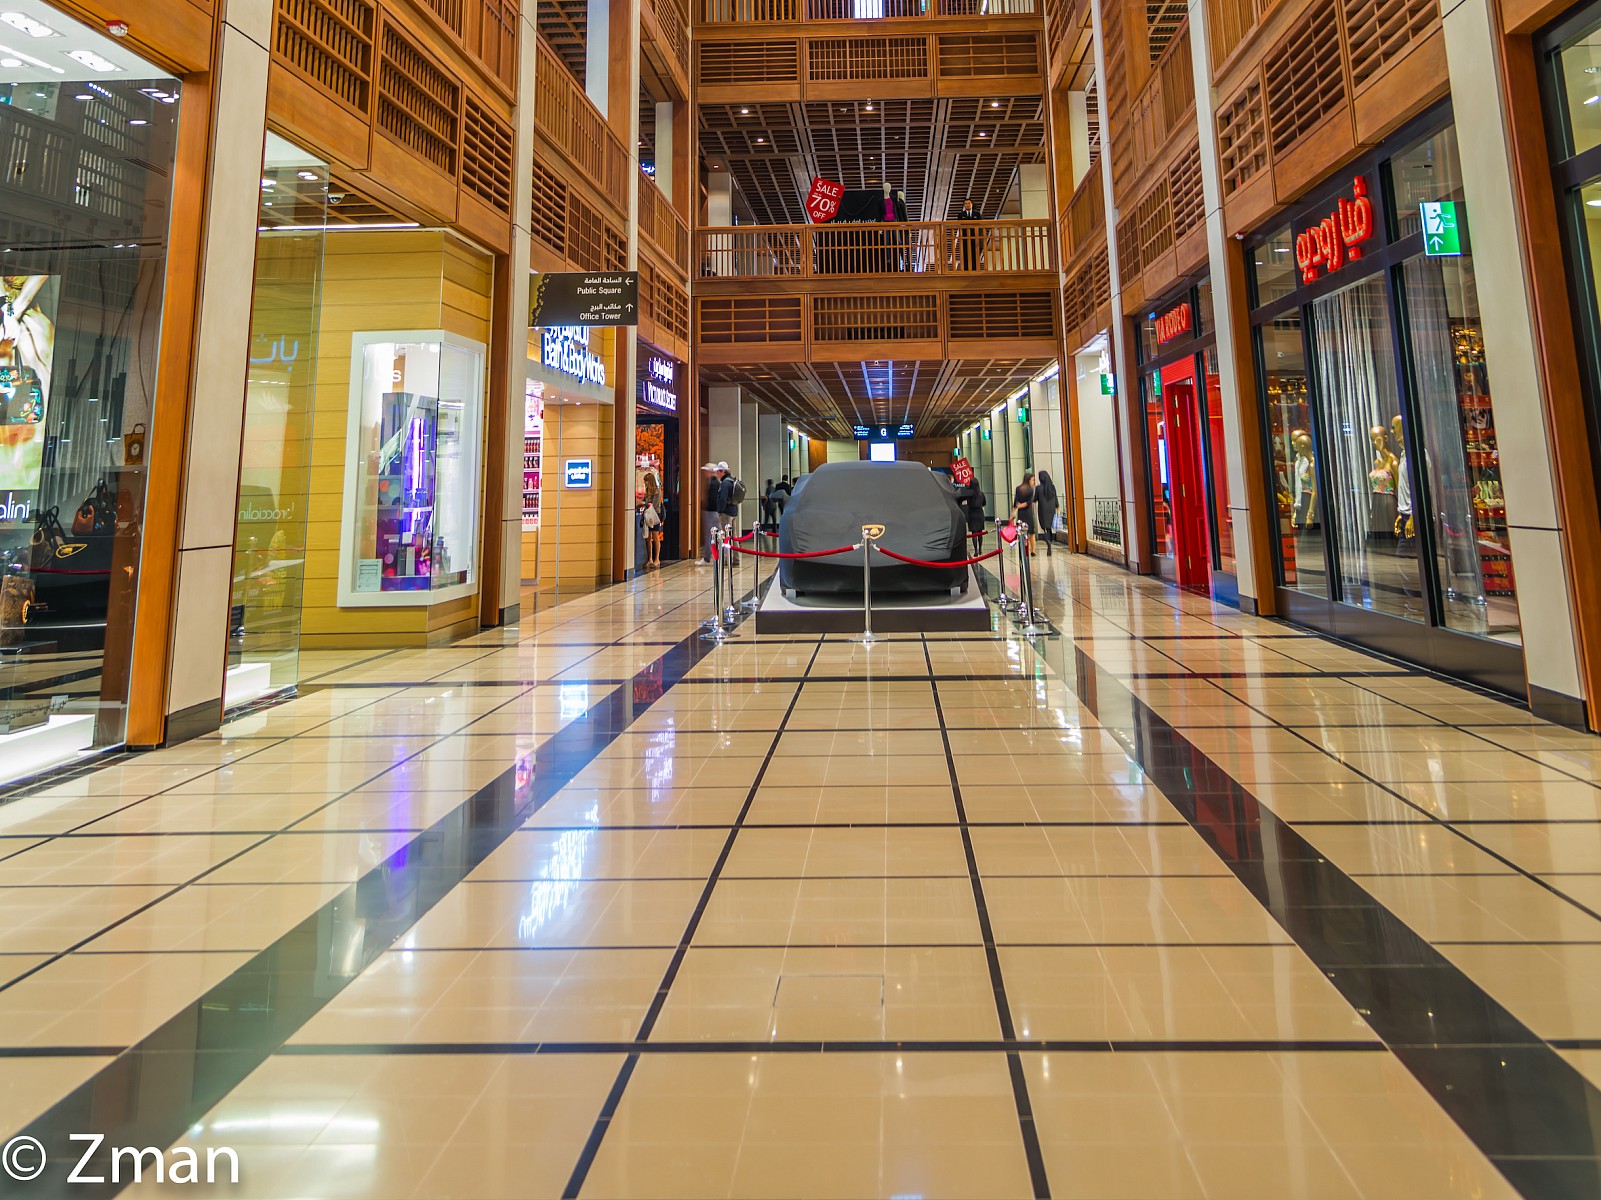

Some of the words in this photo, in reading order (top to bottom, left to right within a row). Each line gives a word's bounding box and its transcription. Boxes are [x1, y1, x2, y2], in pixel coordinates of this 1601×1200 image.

[816, 182, 839, 197] SALE
[810, 194, 837, 213] 70%
[812, 210, 826, 219] OFF
[602, 276, 622, 284] الساحة
[598, 287, 622, 295] Square
[579, 312, 599, 320] Office
[601, 312, 622, 320] Tower
[544, 332, 563, 370] Bath
[569, 340, 588, 384] Body
[880, 427, 887, 437] G
[953, 461, 967, 469] SALE
